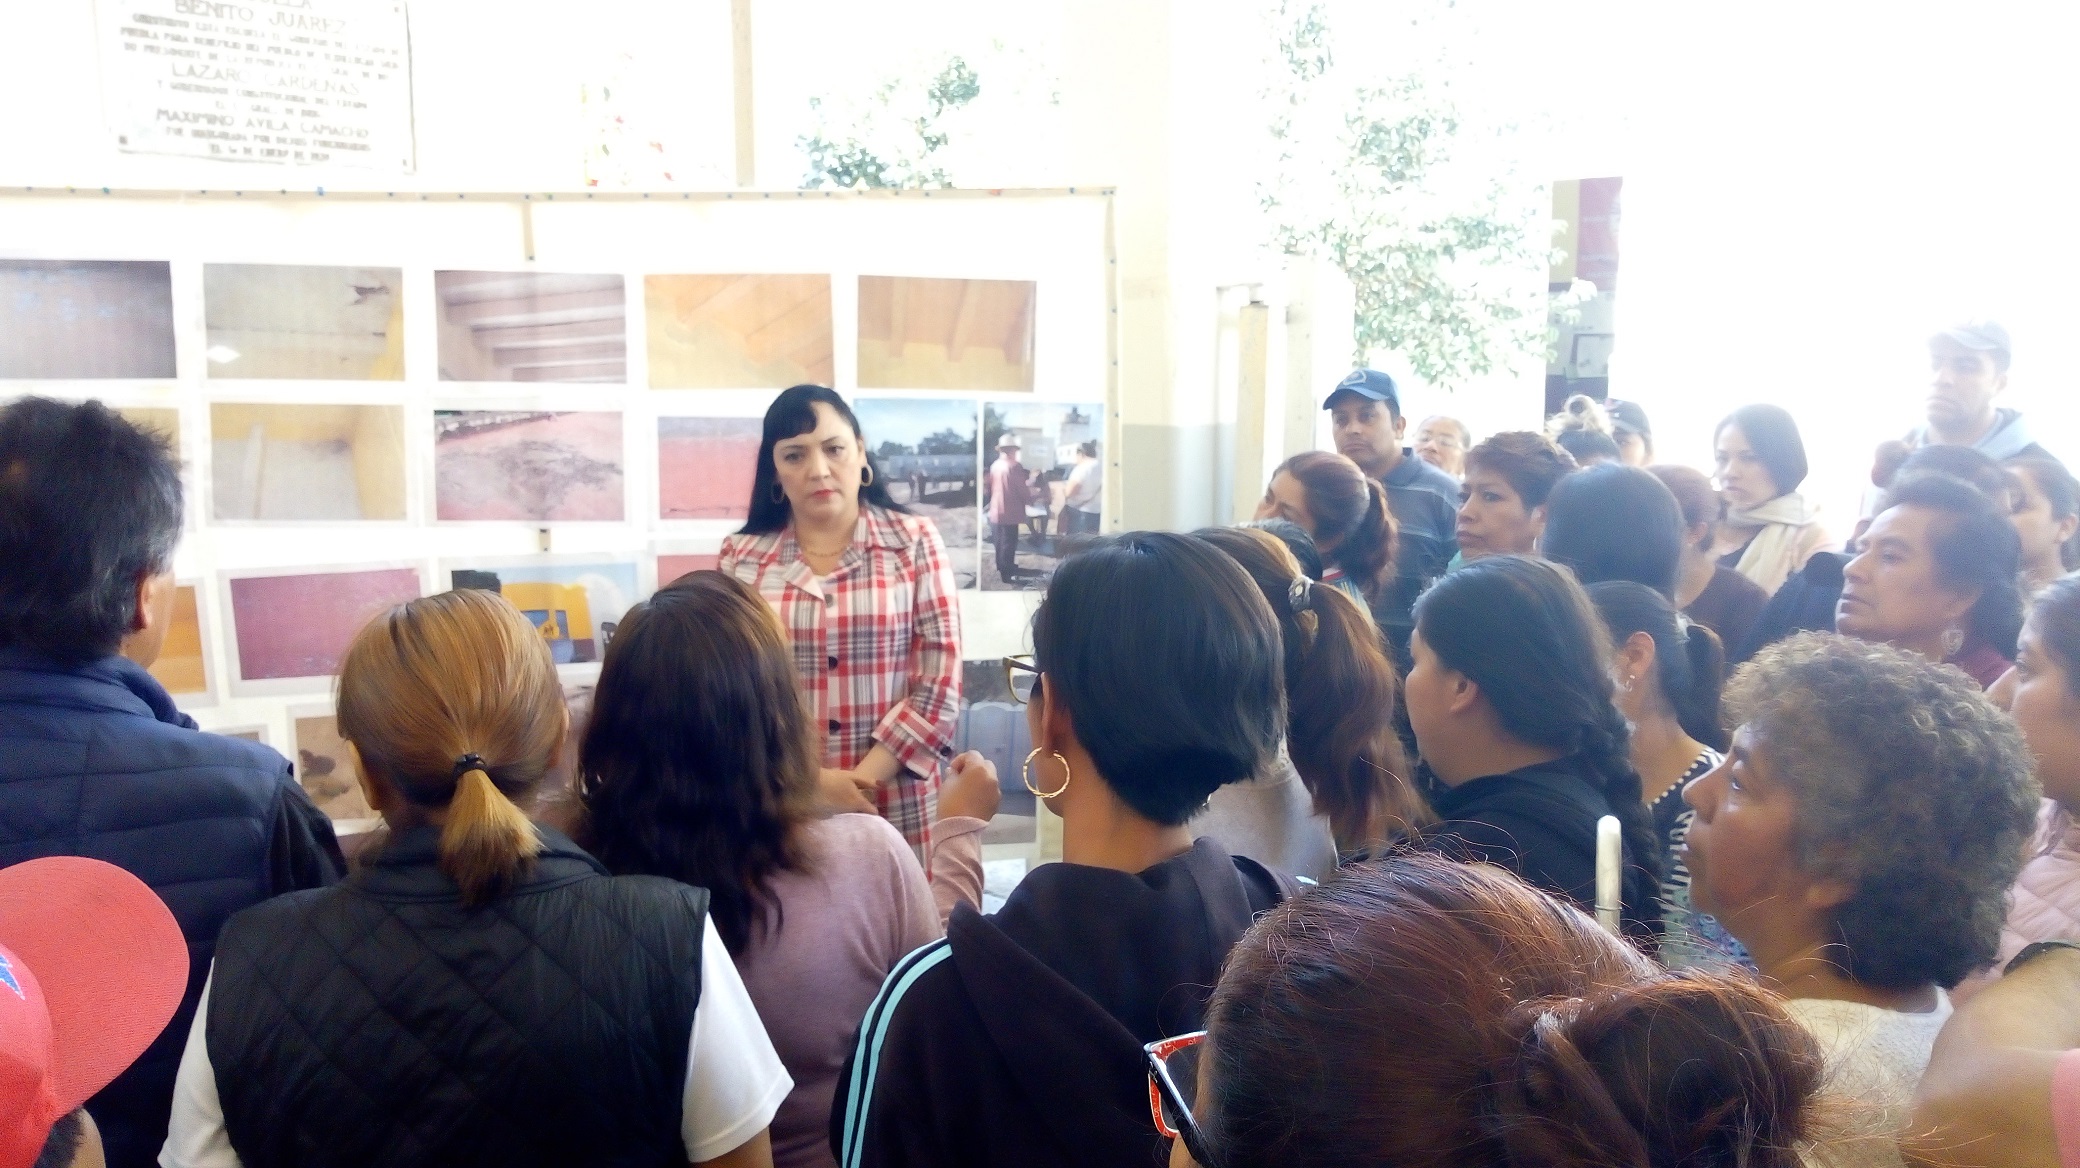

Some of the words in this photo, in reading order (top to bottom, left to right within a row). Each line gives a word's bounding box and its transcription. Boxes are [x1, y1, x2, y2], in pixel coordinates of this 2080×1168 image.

[174, 0, 254, 21] BENITO
[269, 11, 345, 33] JUAREZ
[172, 62, 252, 83] LAZARO
[264, 72, 360, 95] CARDENAS
[245, 117, 290, 132] AVILA
[300, 121, 370, 139] CAMACHO
